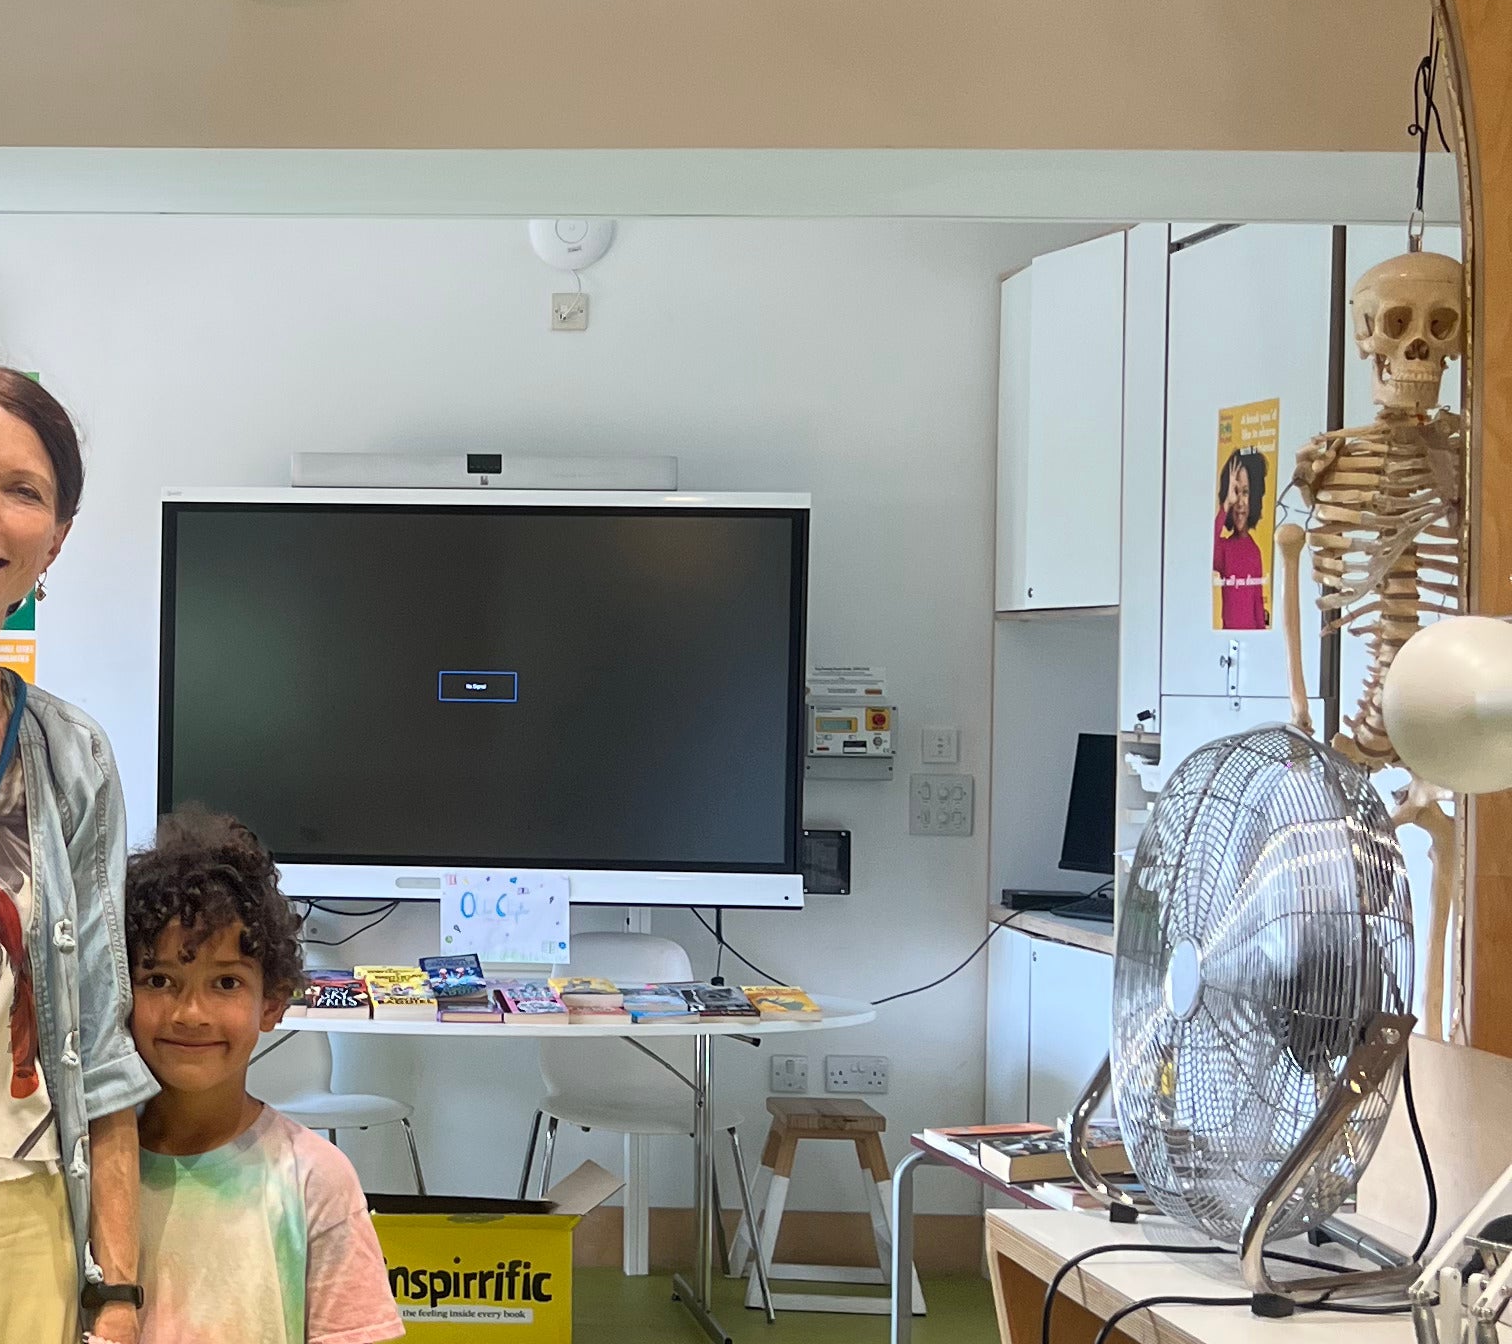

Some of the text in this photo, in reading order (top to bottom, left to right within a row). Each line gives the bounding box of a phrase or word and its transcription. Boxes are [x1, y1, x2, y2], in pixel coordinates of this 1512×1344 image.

[384, 1257, 553, 1308] nspirrific
[403, 1308, 526, 1320] the feeling inside every book
